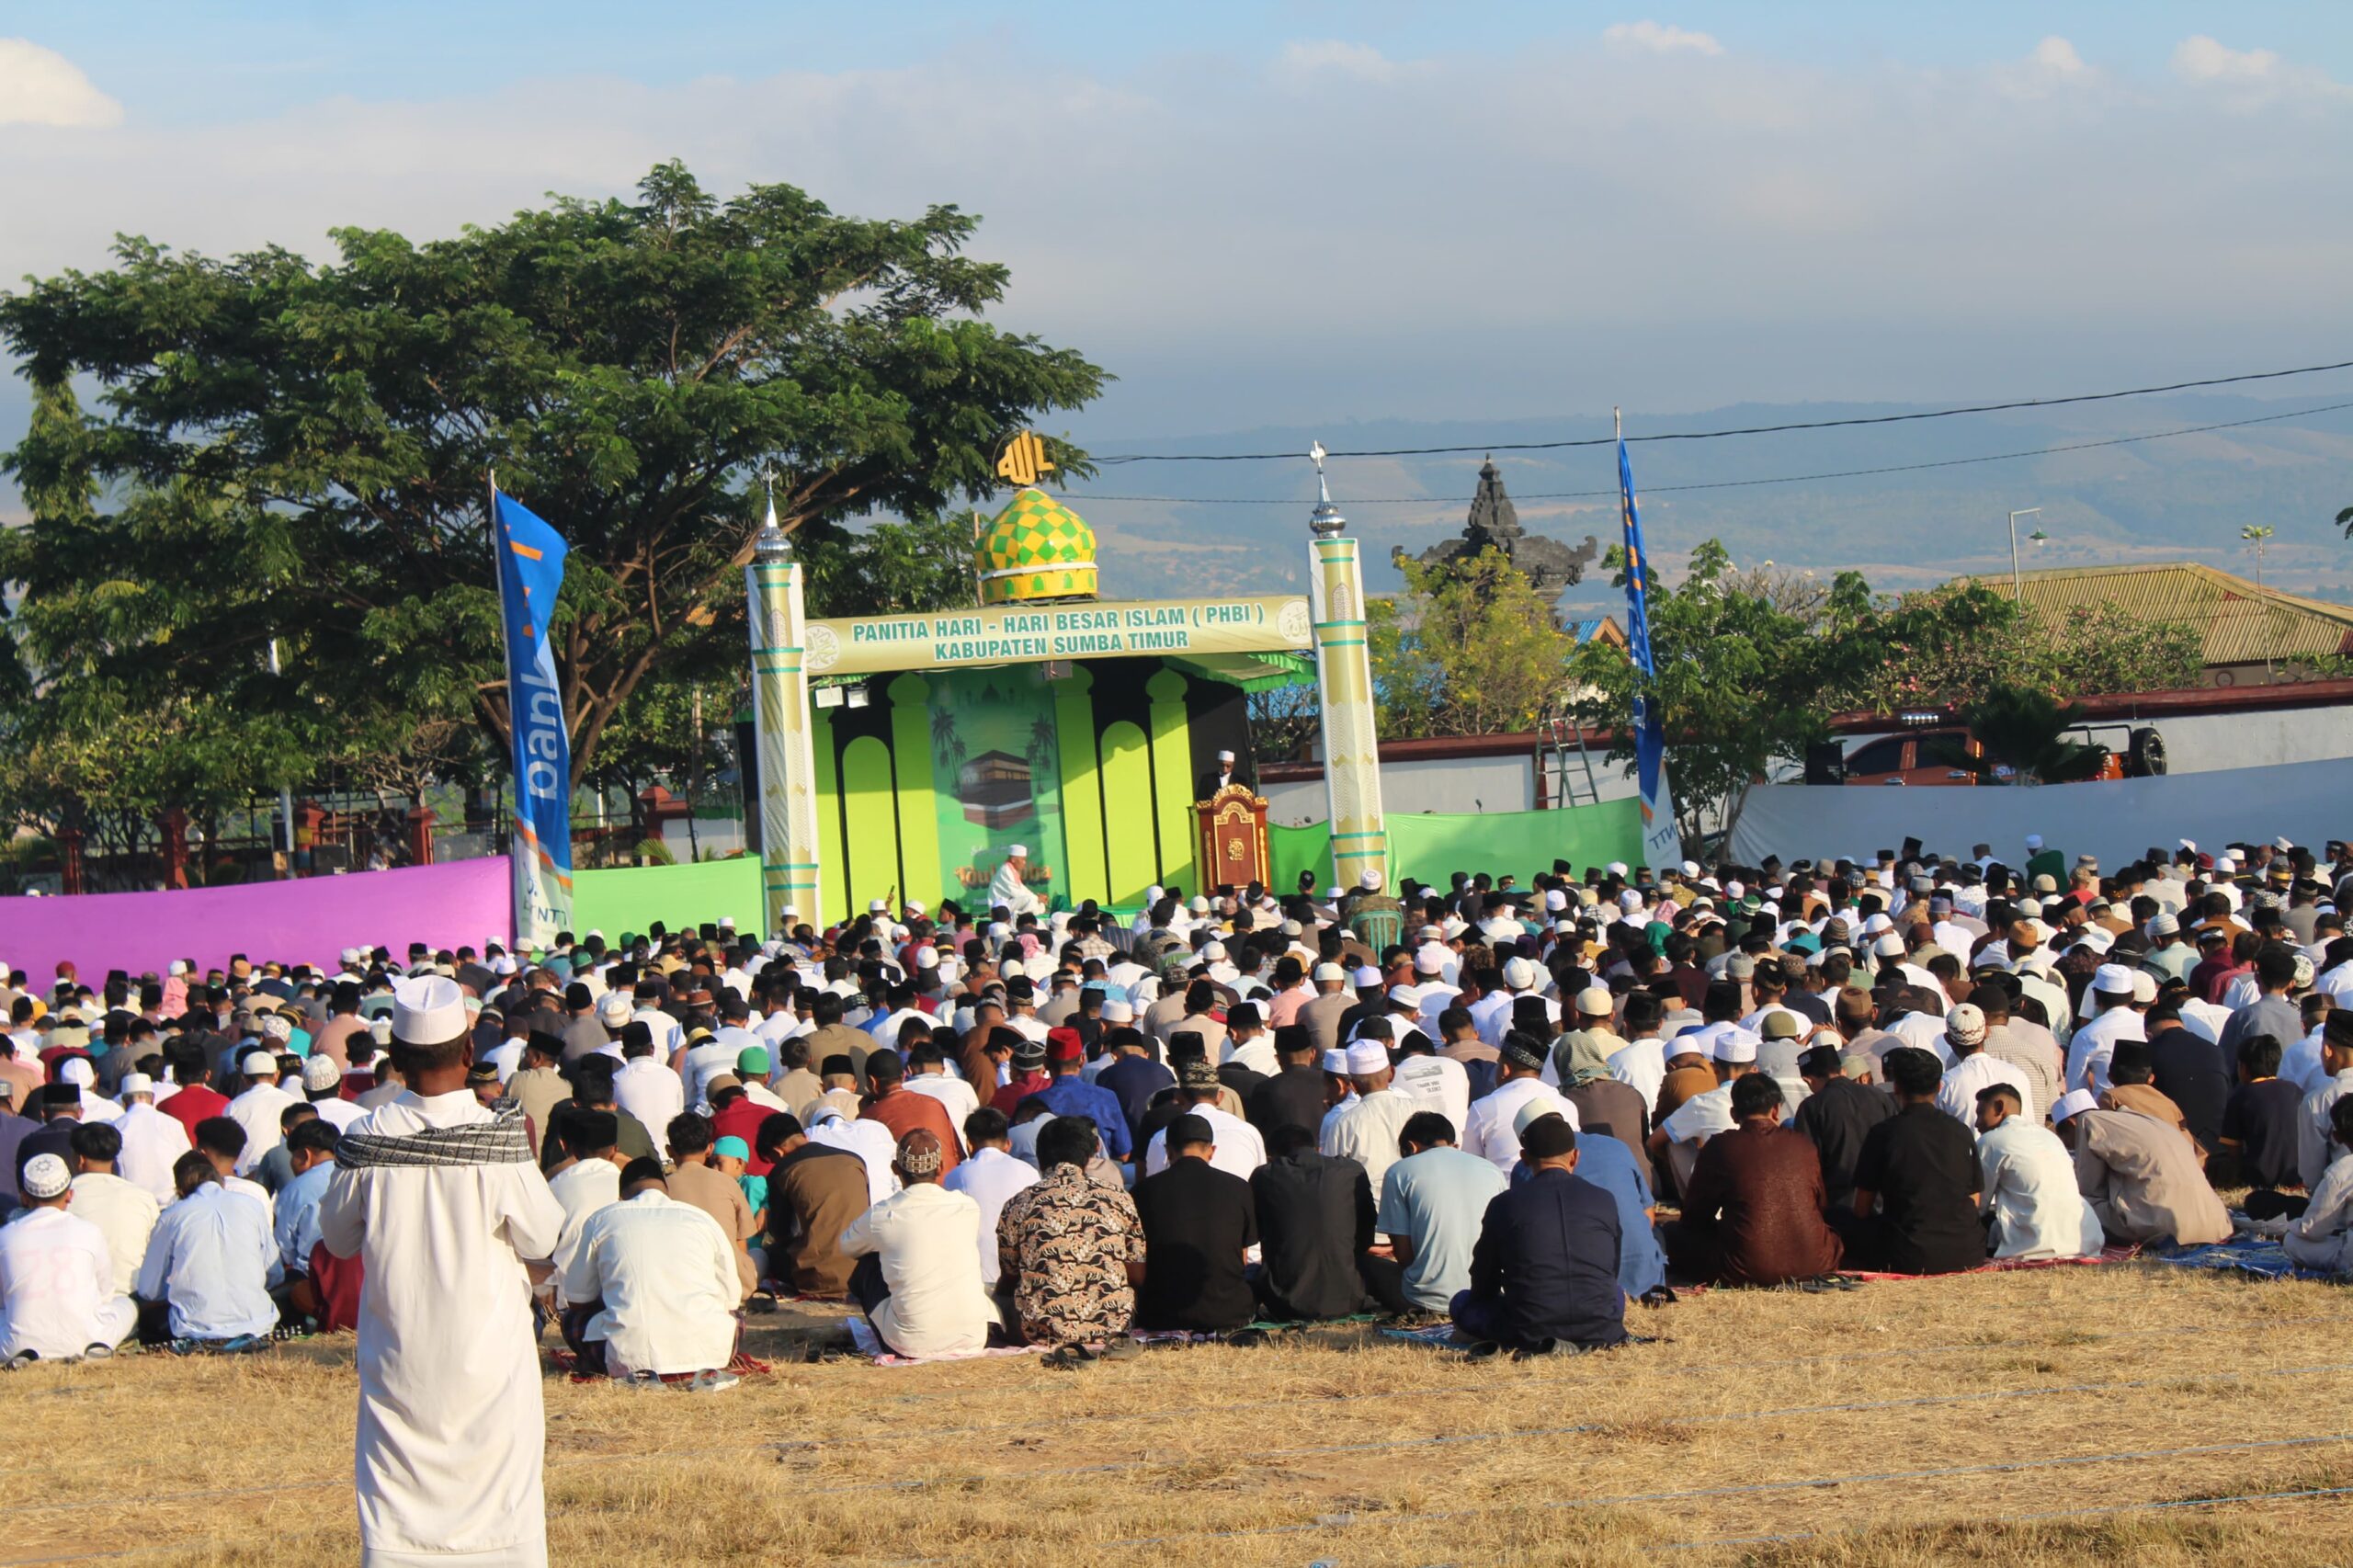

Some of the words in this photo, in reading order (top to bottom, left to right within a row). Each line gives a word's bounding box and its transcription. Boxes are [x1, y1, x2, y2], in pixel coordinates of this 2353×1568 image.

[853, 621, 928, 642] PANITIA
[936, 619, 982, 637] HARI
[1004, 615, 1050, 633] HARI
[1056, 611, 1119, 631] BESAR
[1125, 608, 1185, 627] ISLAM
[1206, 605, 1250, 623] PHBI
[935, 638, 1047, 660] KABUPATEN
[1053, 634, 1122, 653] SUMBA
[1128, 631, 1188, 649] TIMUR
